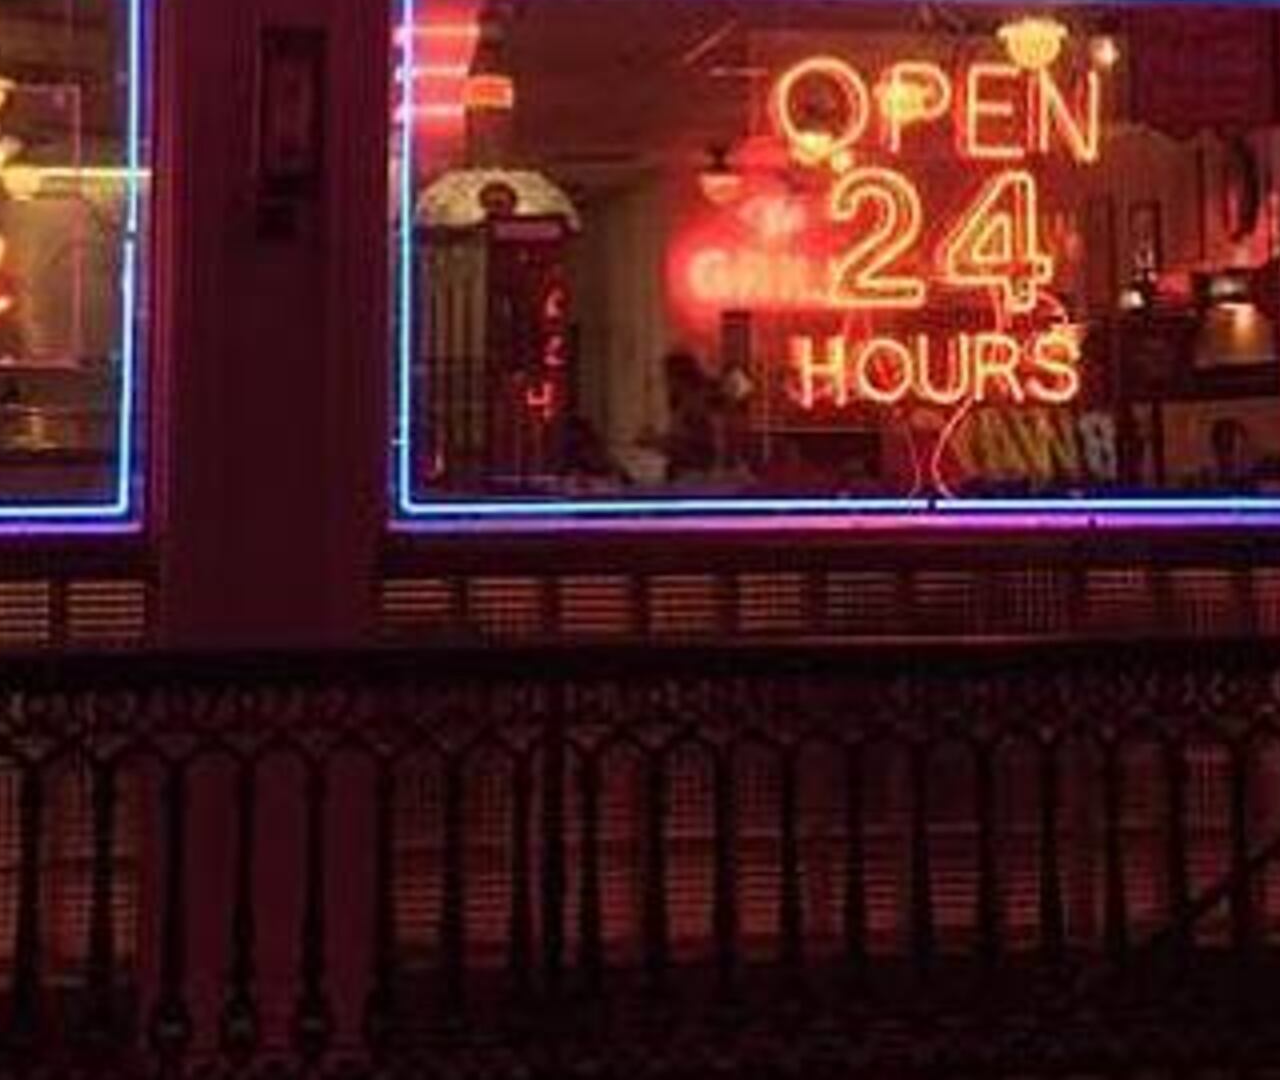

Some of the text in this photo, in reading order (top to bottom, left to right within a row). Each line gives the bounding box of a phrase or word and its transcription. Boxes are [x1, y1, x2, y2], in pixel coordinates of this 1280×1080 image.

[775, 56, 1103, 167] OPEN
[828, 167, 1056, 313] 24
[796, 332, 1081, 409] HOURS
